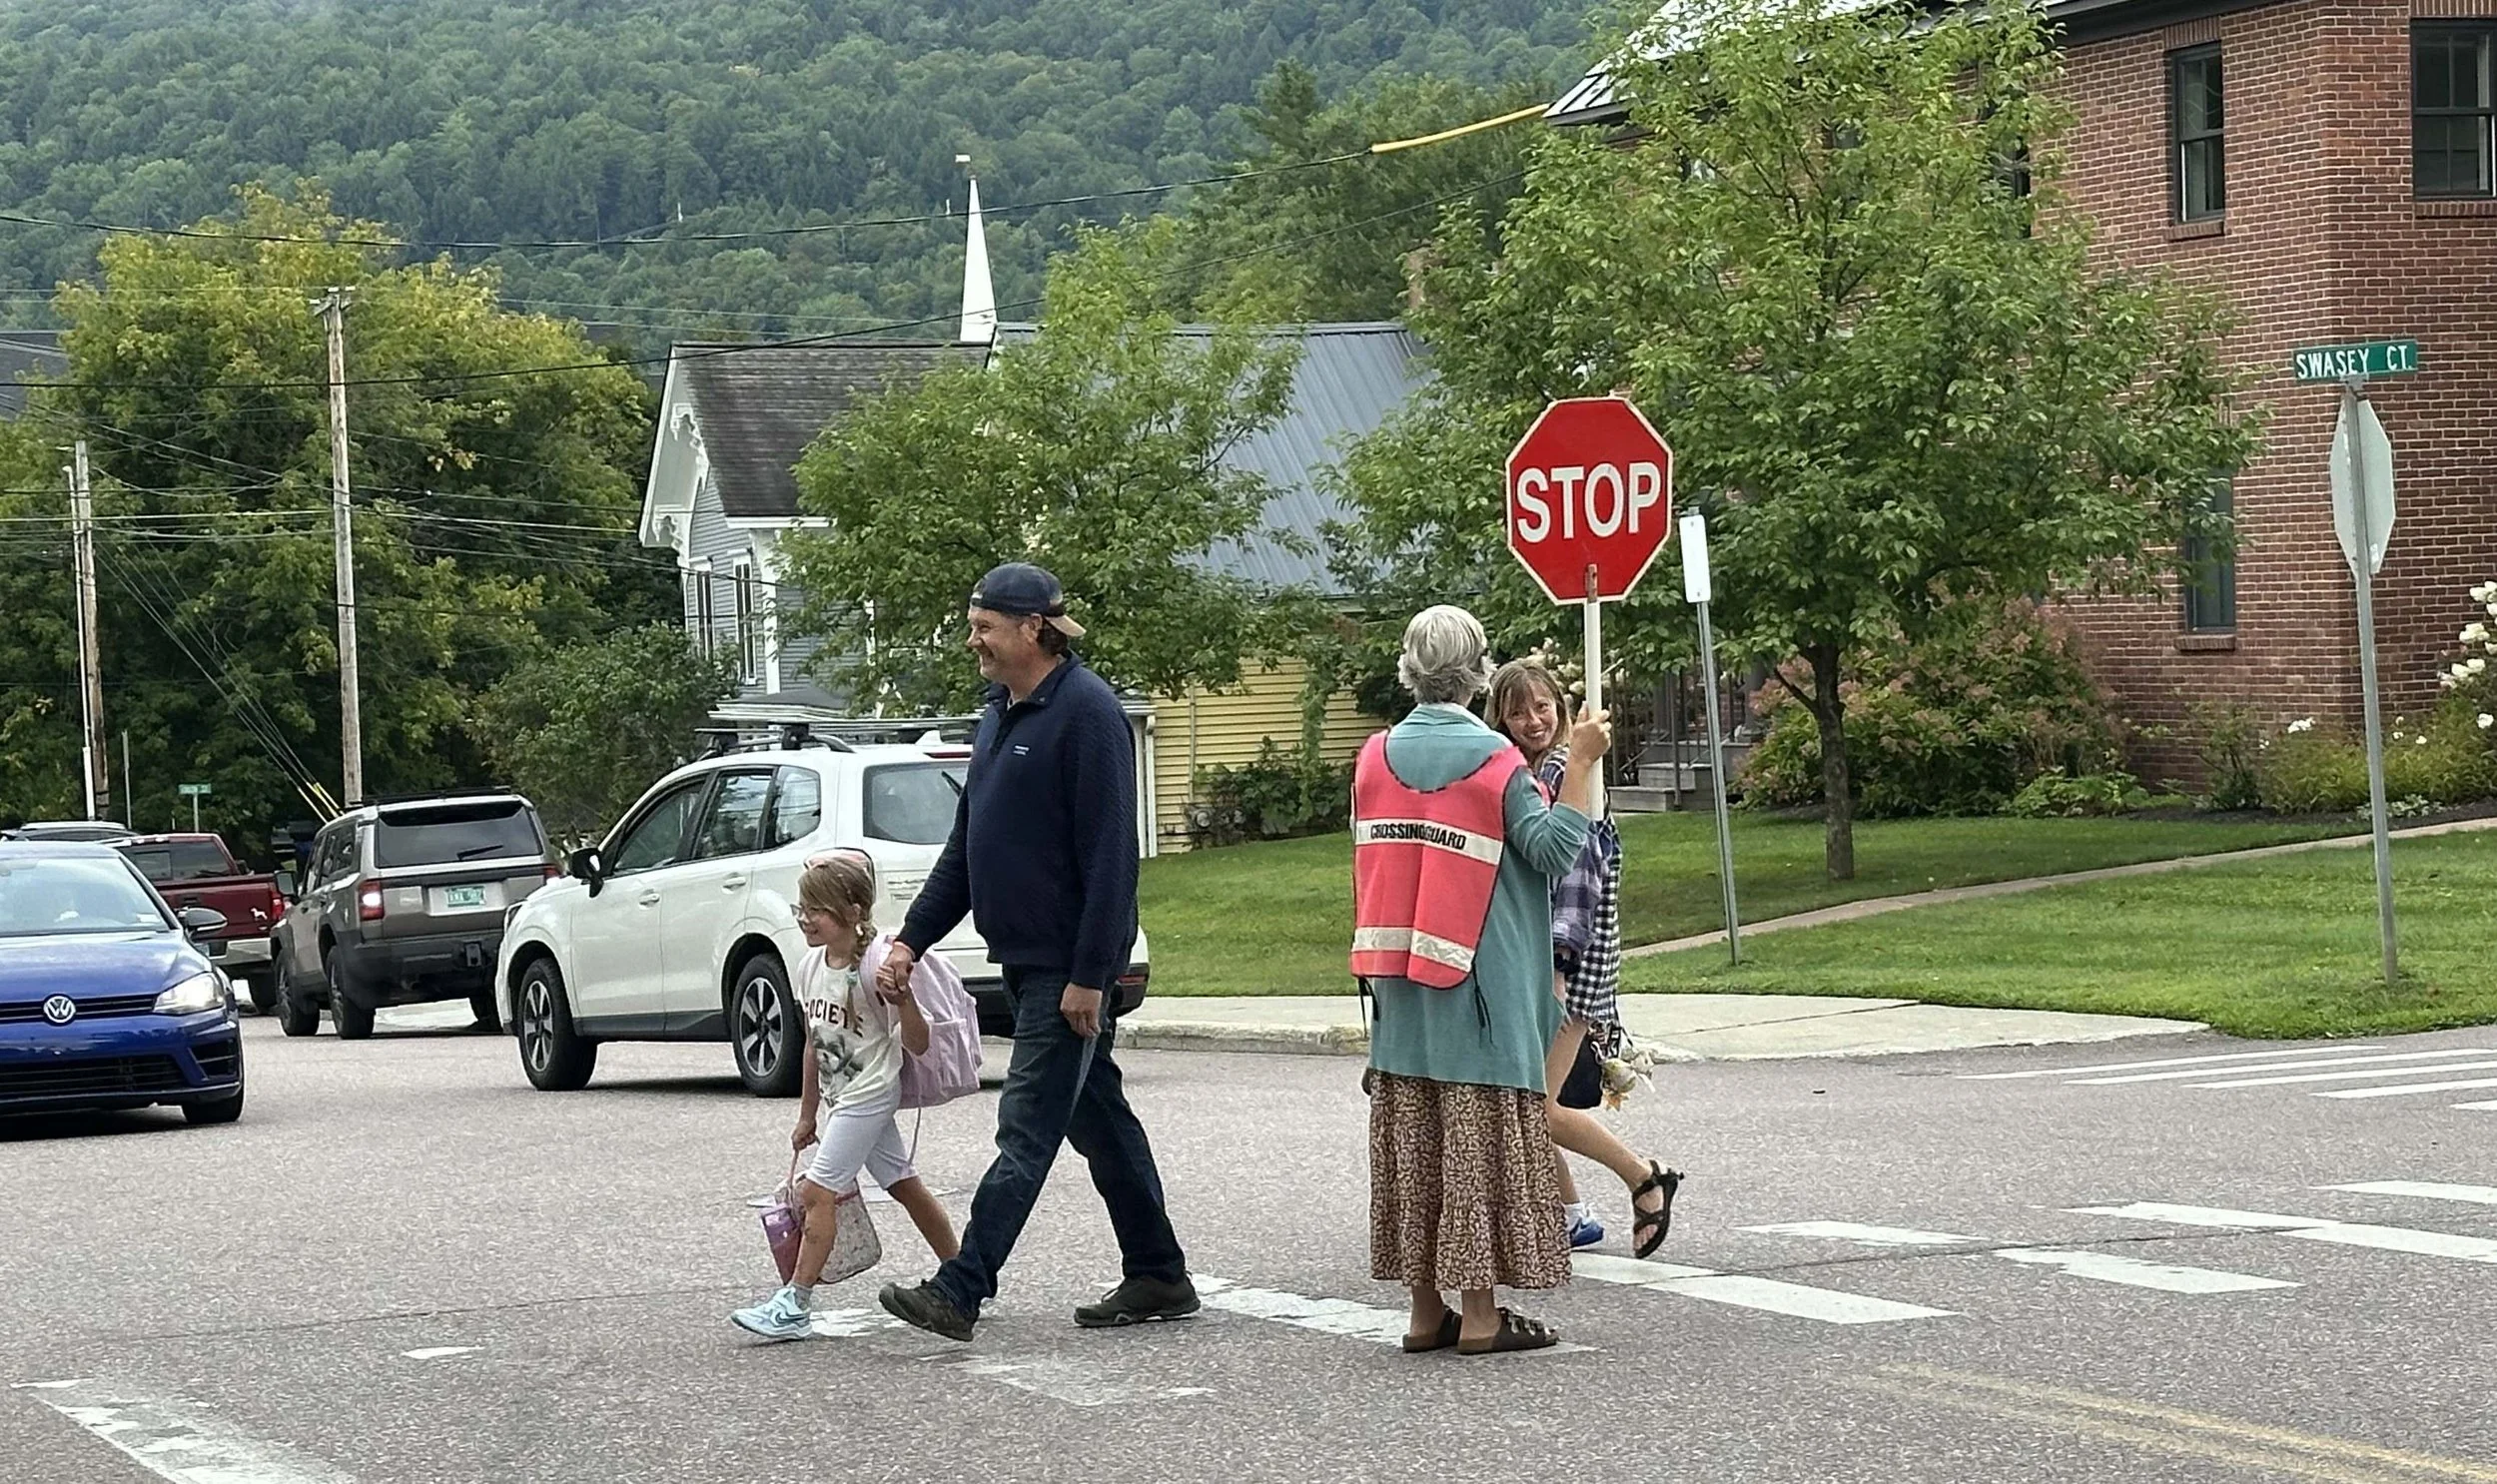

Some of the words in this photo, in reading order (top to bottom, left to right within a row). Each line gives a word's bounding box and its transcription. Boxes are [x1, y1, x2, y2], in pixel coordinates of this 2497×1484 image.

[2296, 348, 2369, 378] SWASEY
[2386, 345, 2412, 371] CT.
[1516, 461, 1661, 543] STOP
[804, 999, 864, 1038] OCIET
